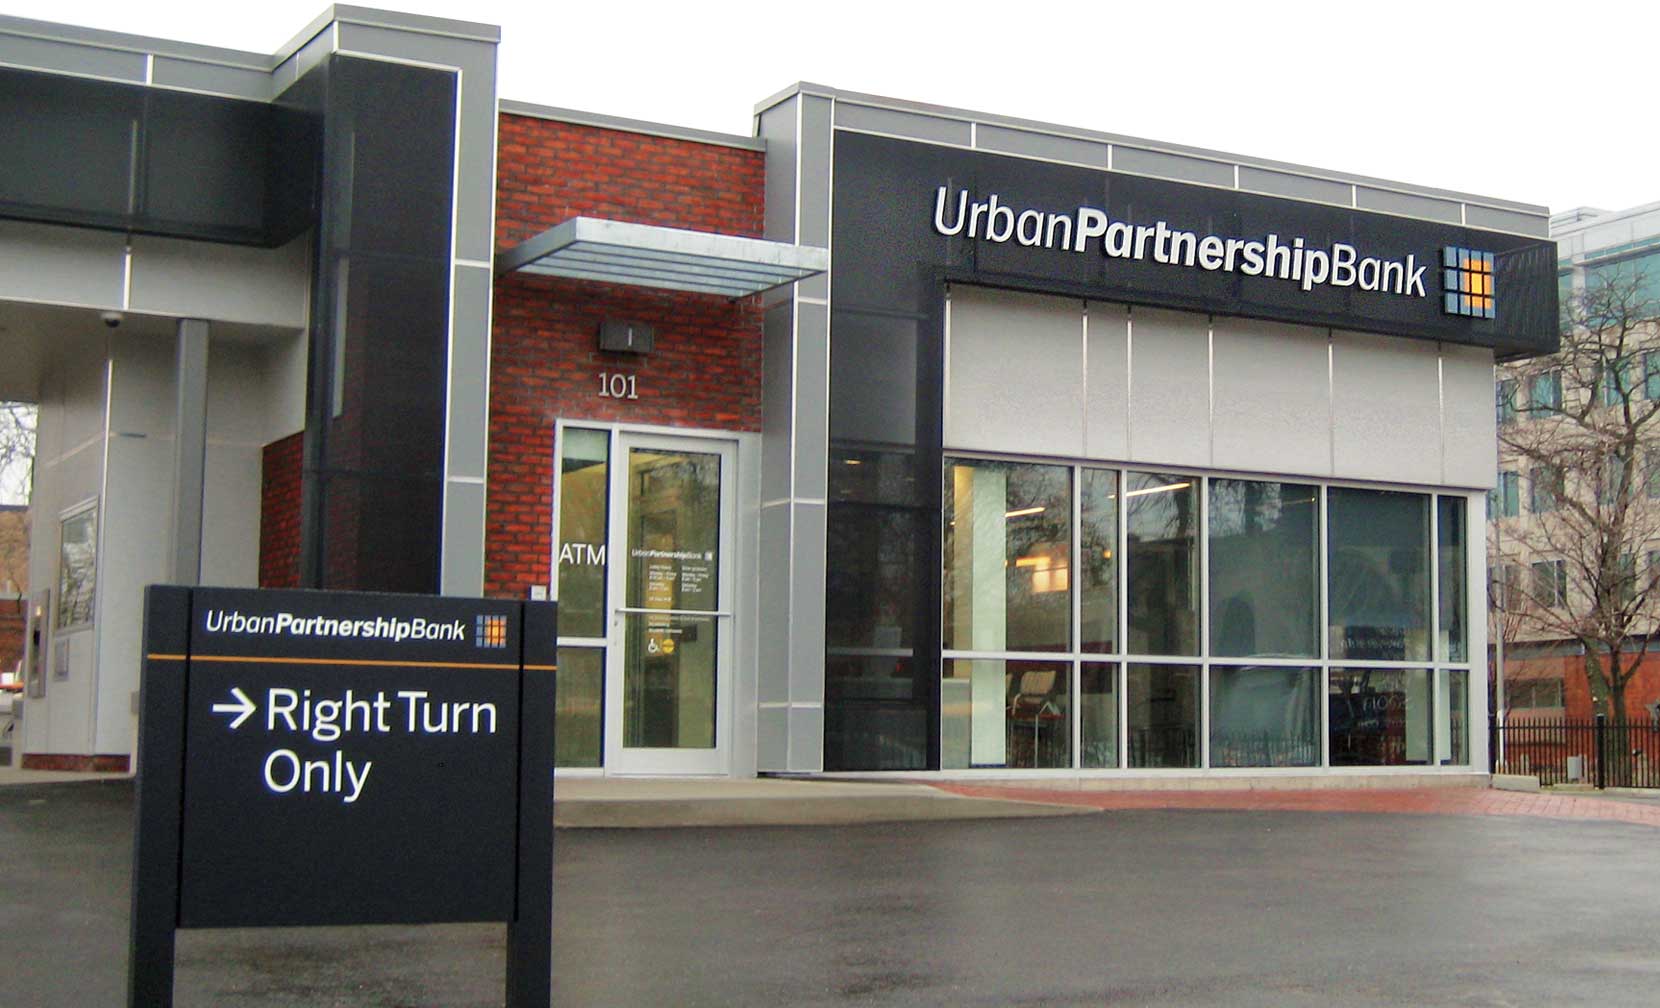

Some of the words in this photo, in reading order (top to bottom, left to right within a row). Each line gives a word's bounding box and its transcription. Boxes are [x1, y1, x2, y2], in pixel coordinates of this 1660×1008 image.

[933, 185, 1430, 299] UrbanPartnershipBank
[598, 372, 639, 400] 101
[559, 543, 606, 566] ATM
[205, 609, 466, 643] UrbanPartnershipBank
[266, 687, 391, 742] Right
[397, 690, 497, 734] Turn
[264, 748, 373, 804] Only
